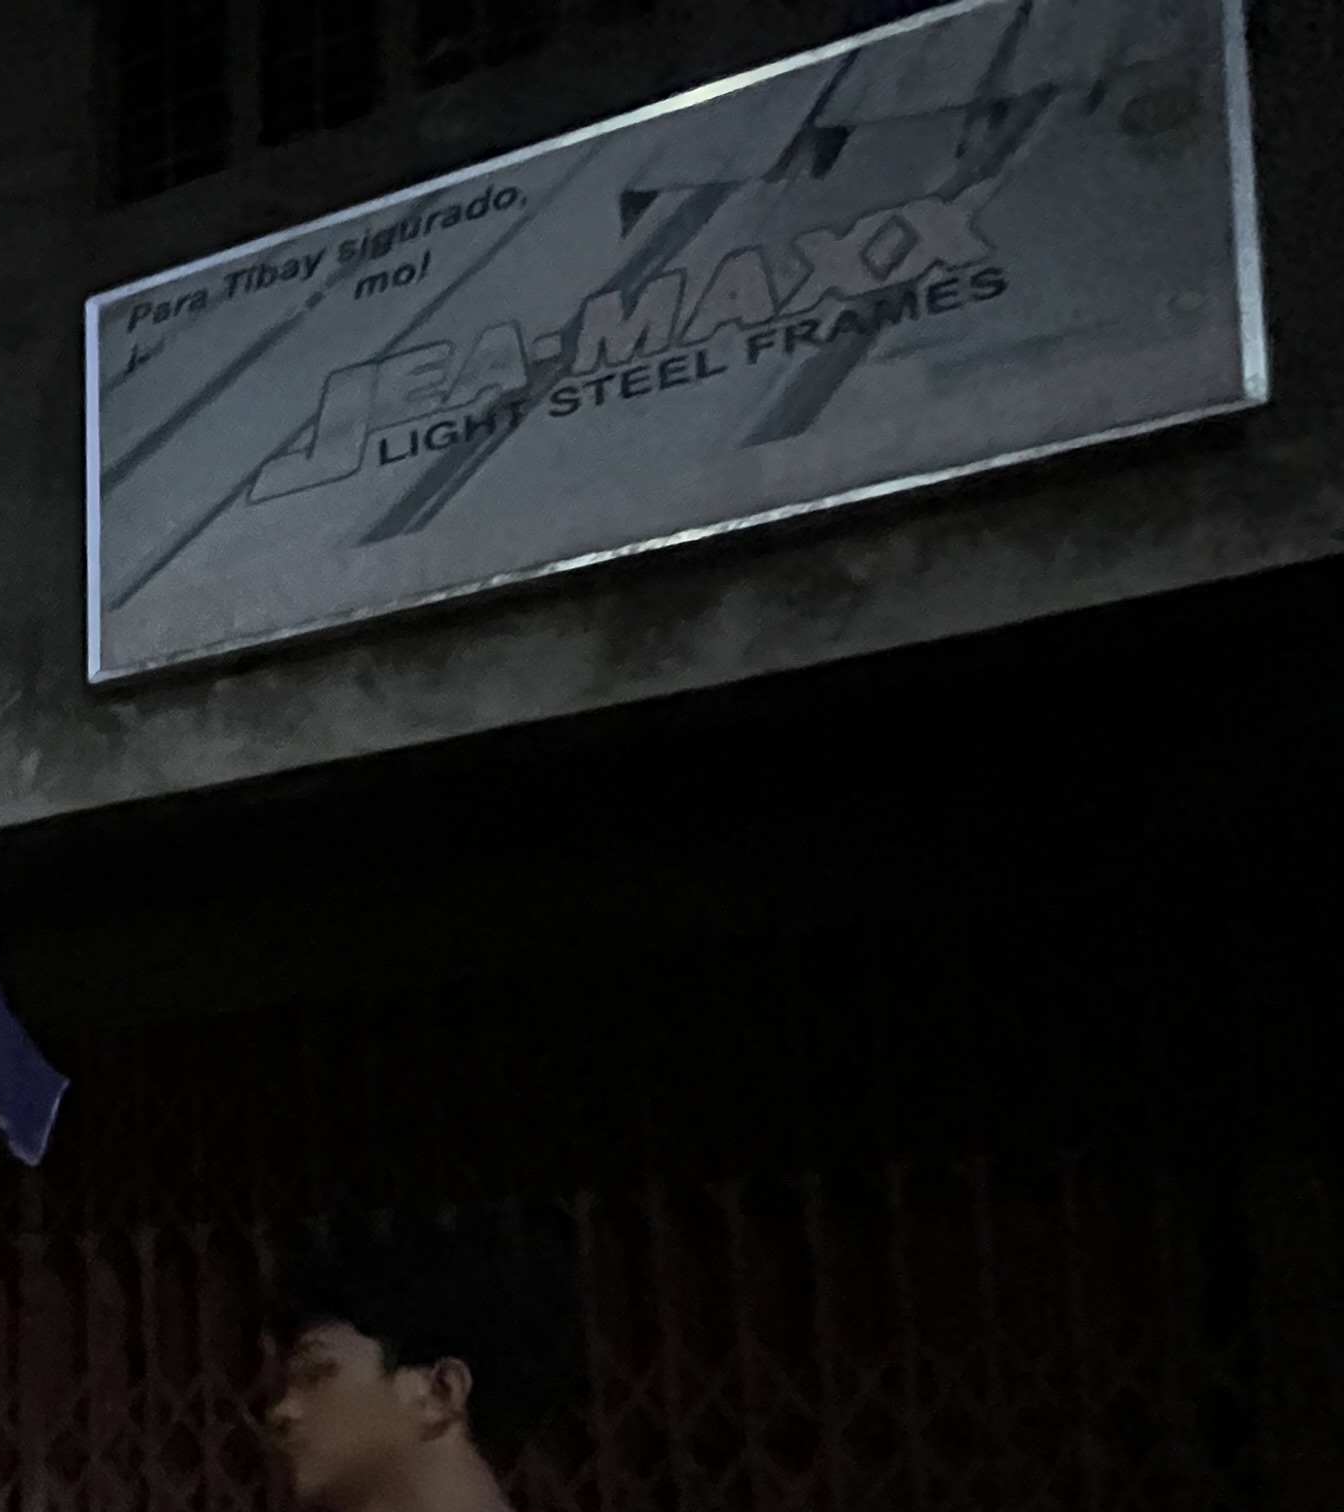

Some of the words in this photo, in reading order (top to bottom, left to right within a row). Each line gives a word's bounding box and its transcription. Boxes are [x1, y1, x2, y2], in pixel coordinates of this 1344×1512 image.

[127, 287, 208, 333] Para
[225, 247, 328, 297] Tibay
[354, 250, 432, 299] mo!
[378, 402, 526, 465] LIGHT
[549, 347, 727, 420] STEEL
[745, 267, 1009, 365] FRAMES
